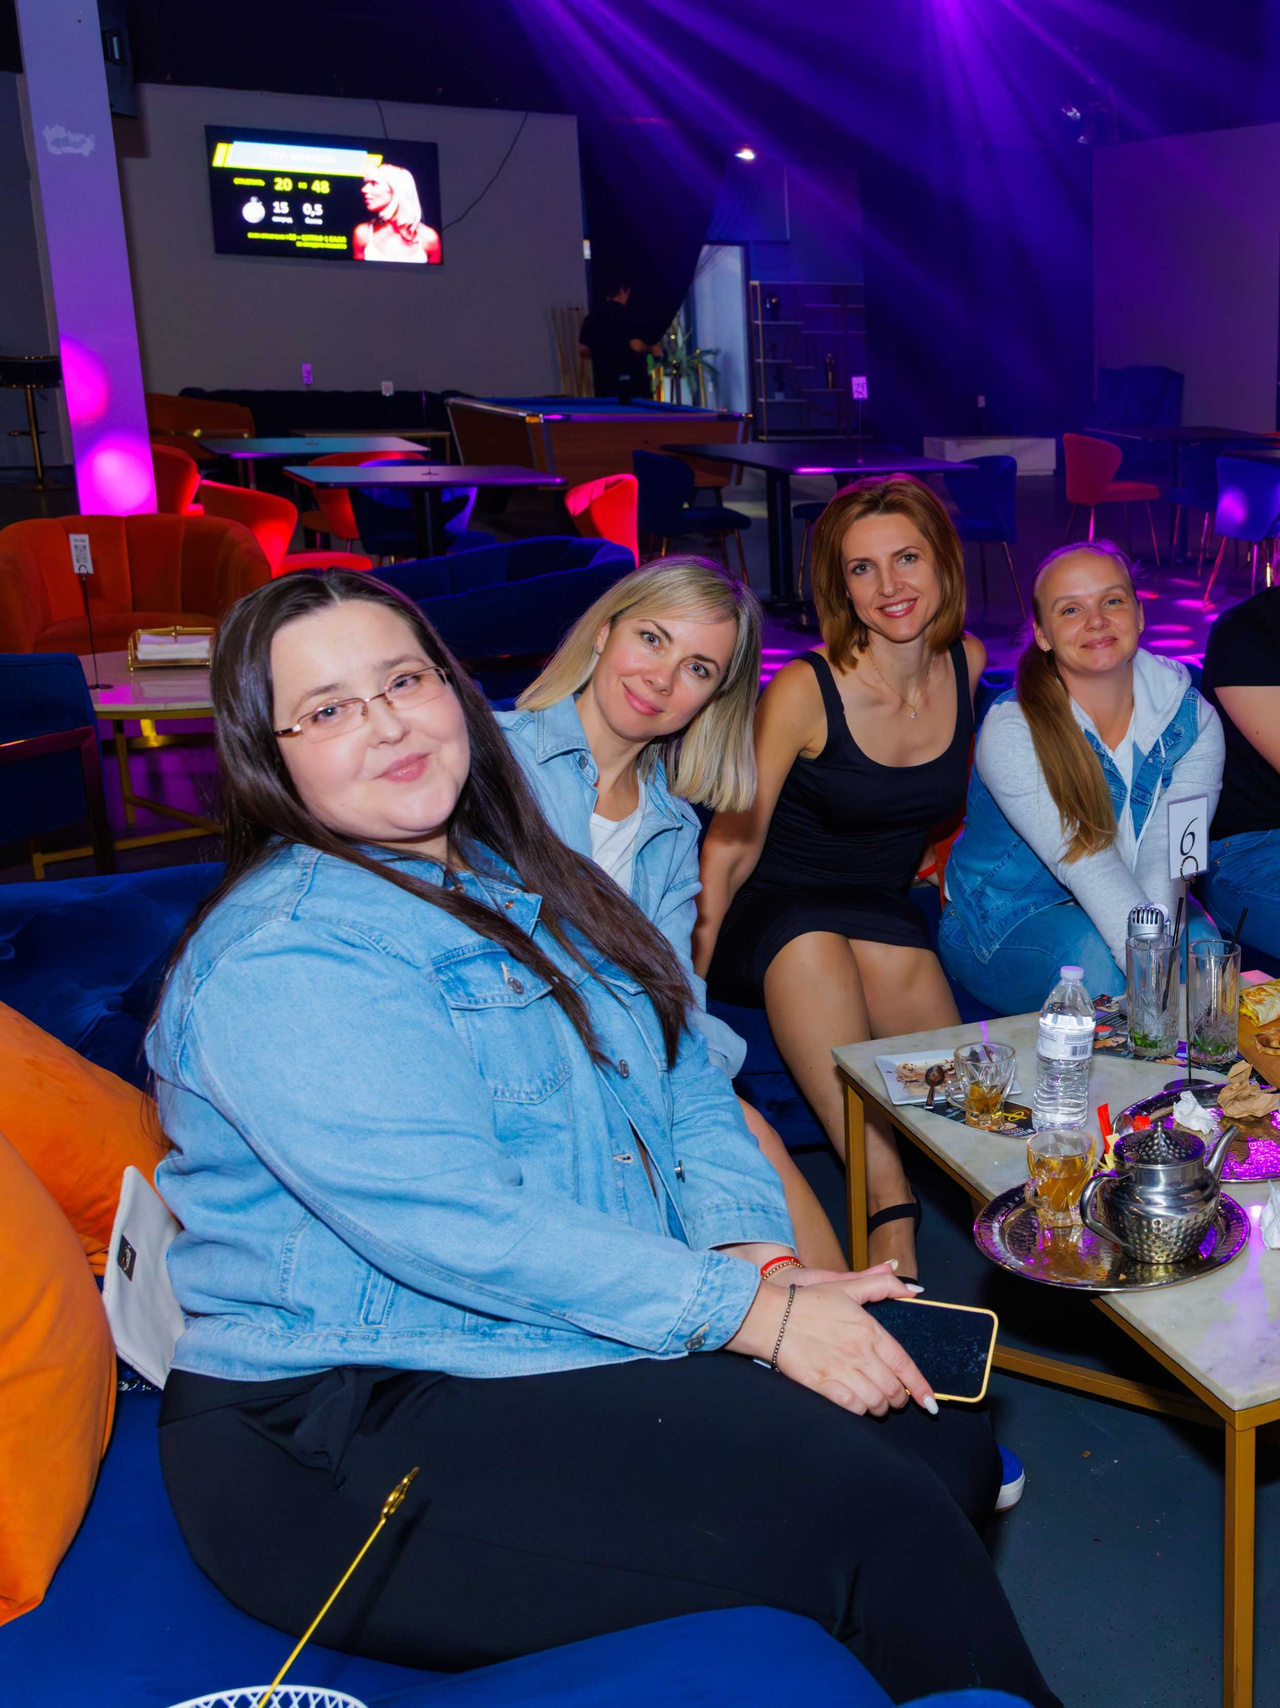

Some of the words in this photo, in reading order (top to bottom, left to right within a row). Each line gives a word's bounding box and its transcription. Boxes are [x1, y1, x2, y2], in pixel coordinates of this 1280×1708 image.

[274, 177, 293, 191] 20
[311, 180, 330, 194] 48
[272, 201, 289, 214] 15
[1180, 816, 1199, 856] 6
